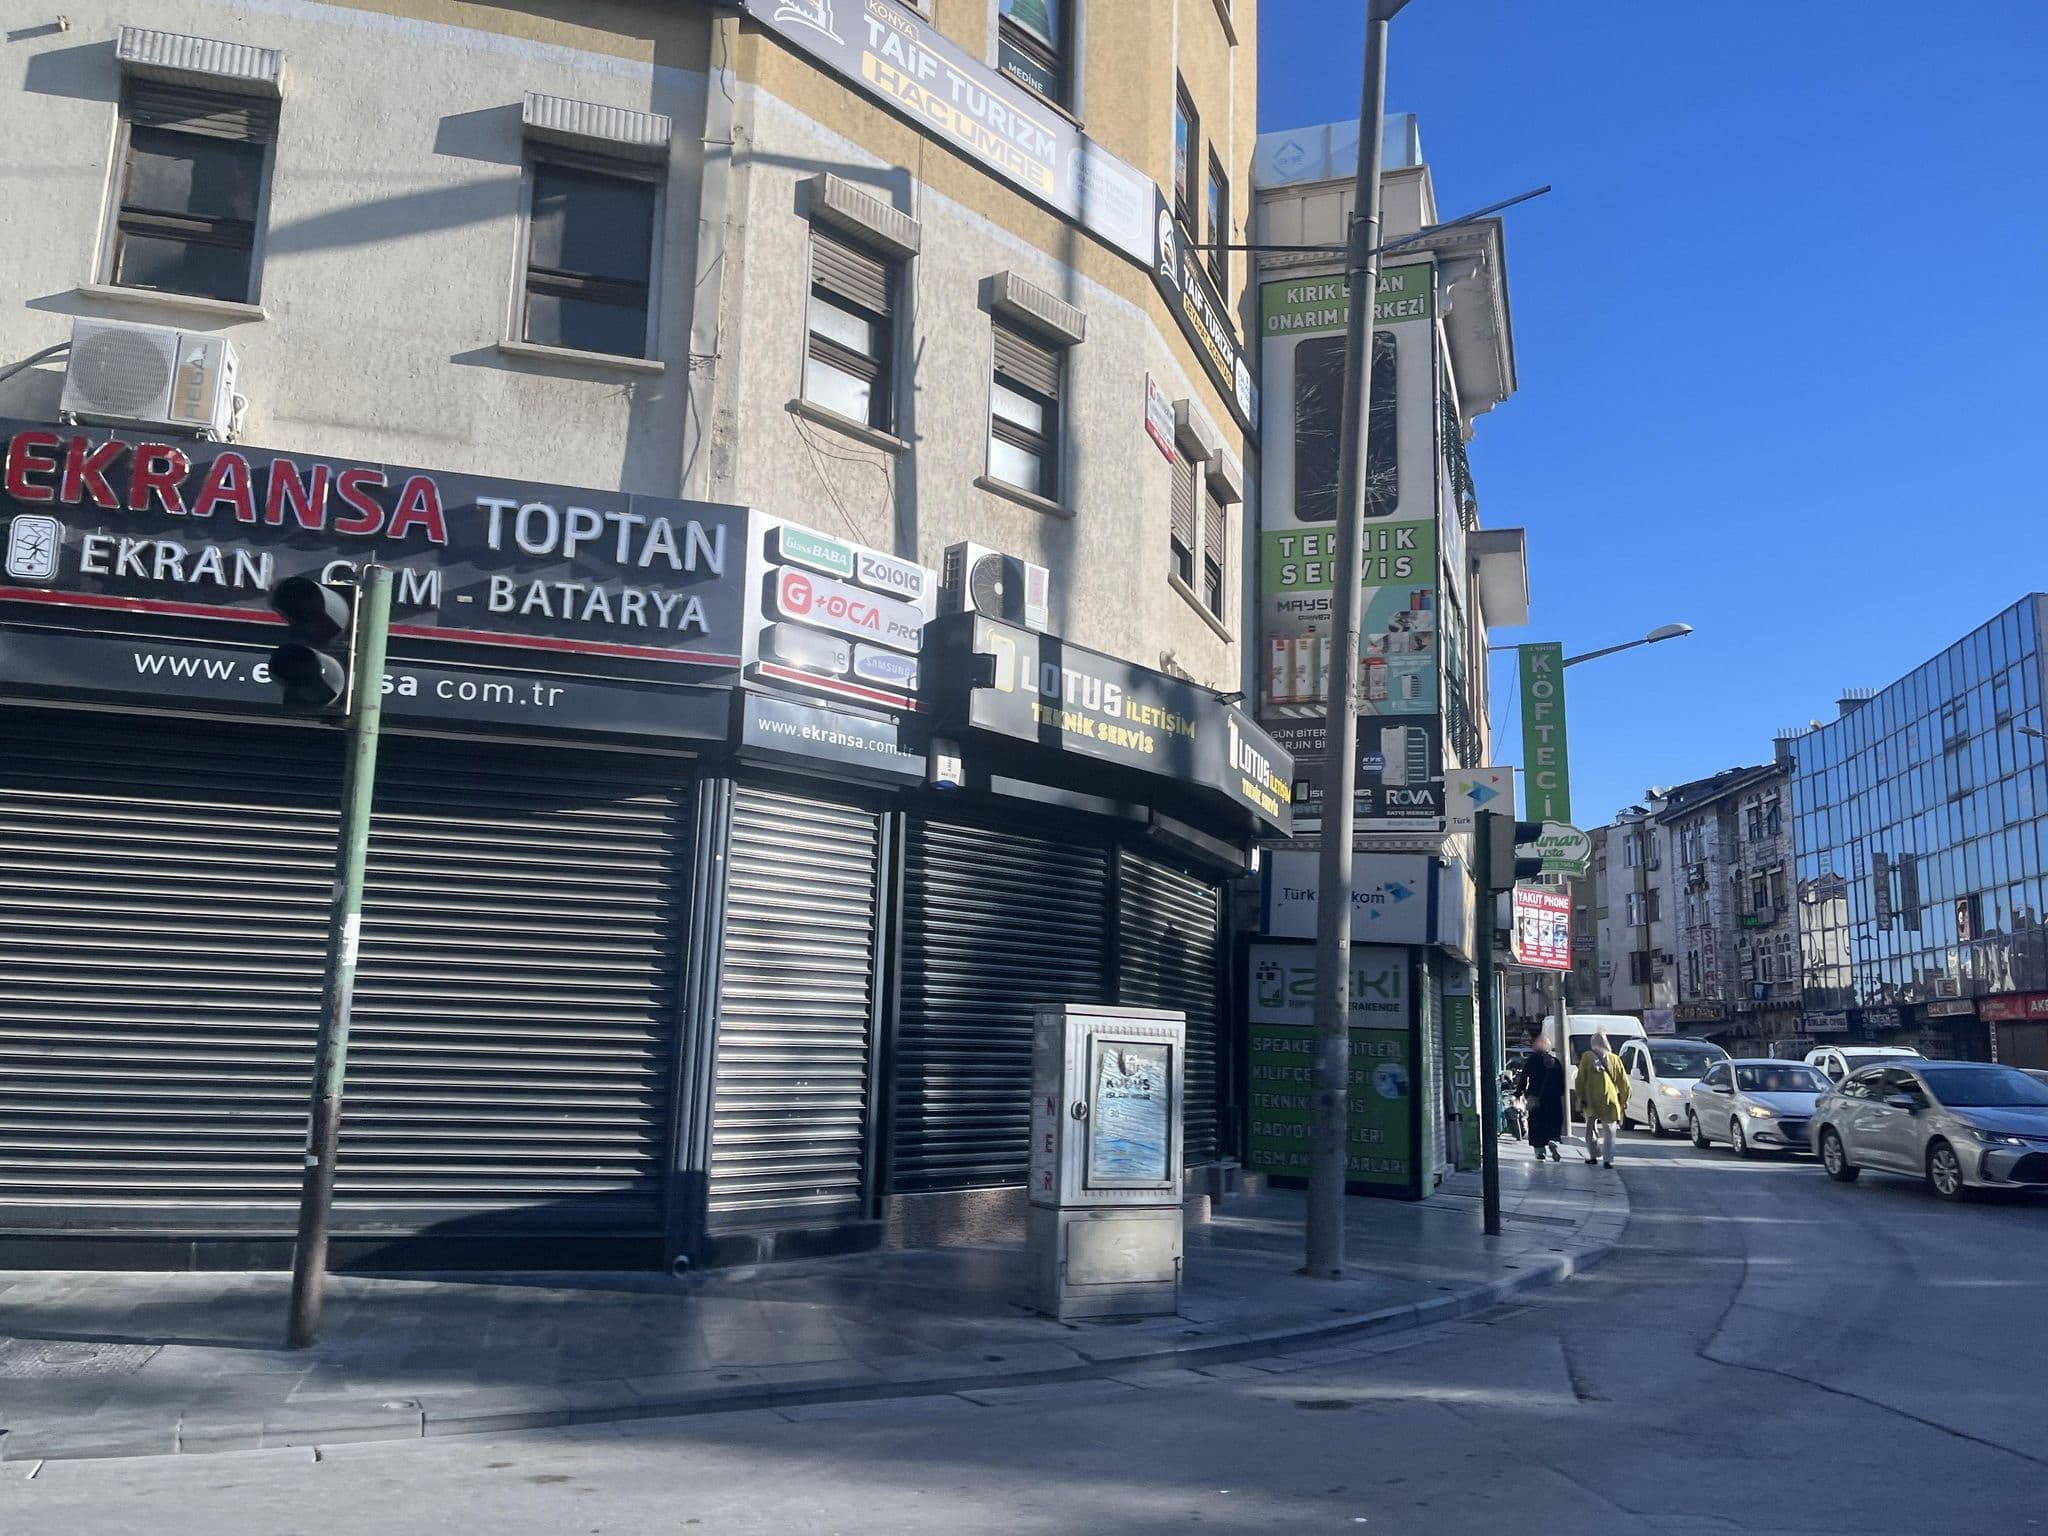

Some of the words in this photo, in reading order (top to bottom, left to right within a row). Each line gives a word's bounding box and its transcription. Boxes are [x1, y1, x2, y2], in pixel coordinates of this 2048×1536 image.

[868, 0, 914, 37] KONYA
[1008, 61, 1044, 93] MEDİNE
[1286, 285, 1337, 304] KIRIK
[1342, 275, 1405, 299] EAN
[1267, 309, 1338, 332] ONARIM
[5, 432, 449, 546] EKRANSA
[476, 497, 727, 575] TOPTAN
[79, 533, 274, 591] EKRAN
[320, 559, 442, 609] CM
[487, 574, 712, 634] BATARYA
[1277, 599, 1333, 613] MAYS
[865, 657, 911, 676] SAMSUNG
[1021, 655, 1122, 718] LOTUS
[1125, 695, 1196, 738] İLETİŞİM
[757, 717, 913, 758] www.ekransa.com.tr
[1031, 702, 1095, 738] TEKNİK
[1097, 722, 1154, 754] SERVİS
[1239, 738, 1270, 788] LOTUS
[1385, 789, 1435, 805] ROVA
[1282, 886, 1315, 902] Türk
[1517, 891, 1543, 906] YAKUT
[1543, 895, 1569, 910] PHONE
